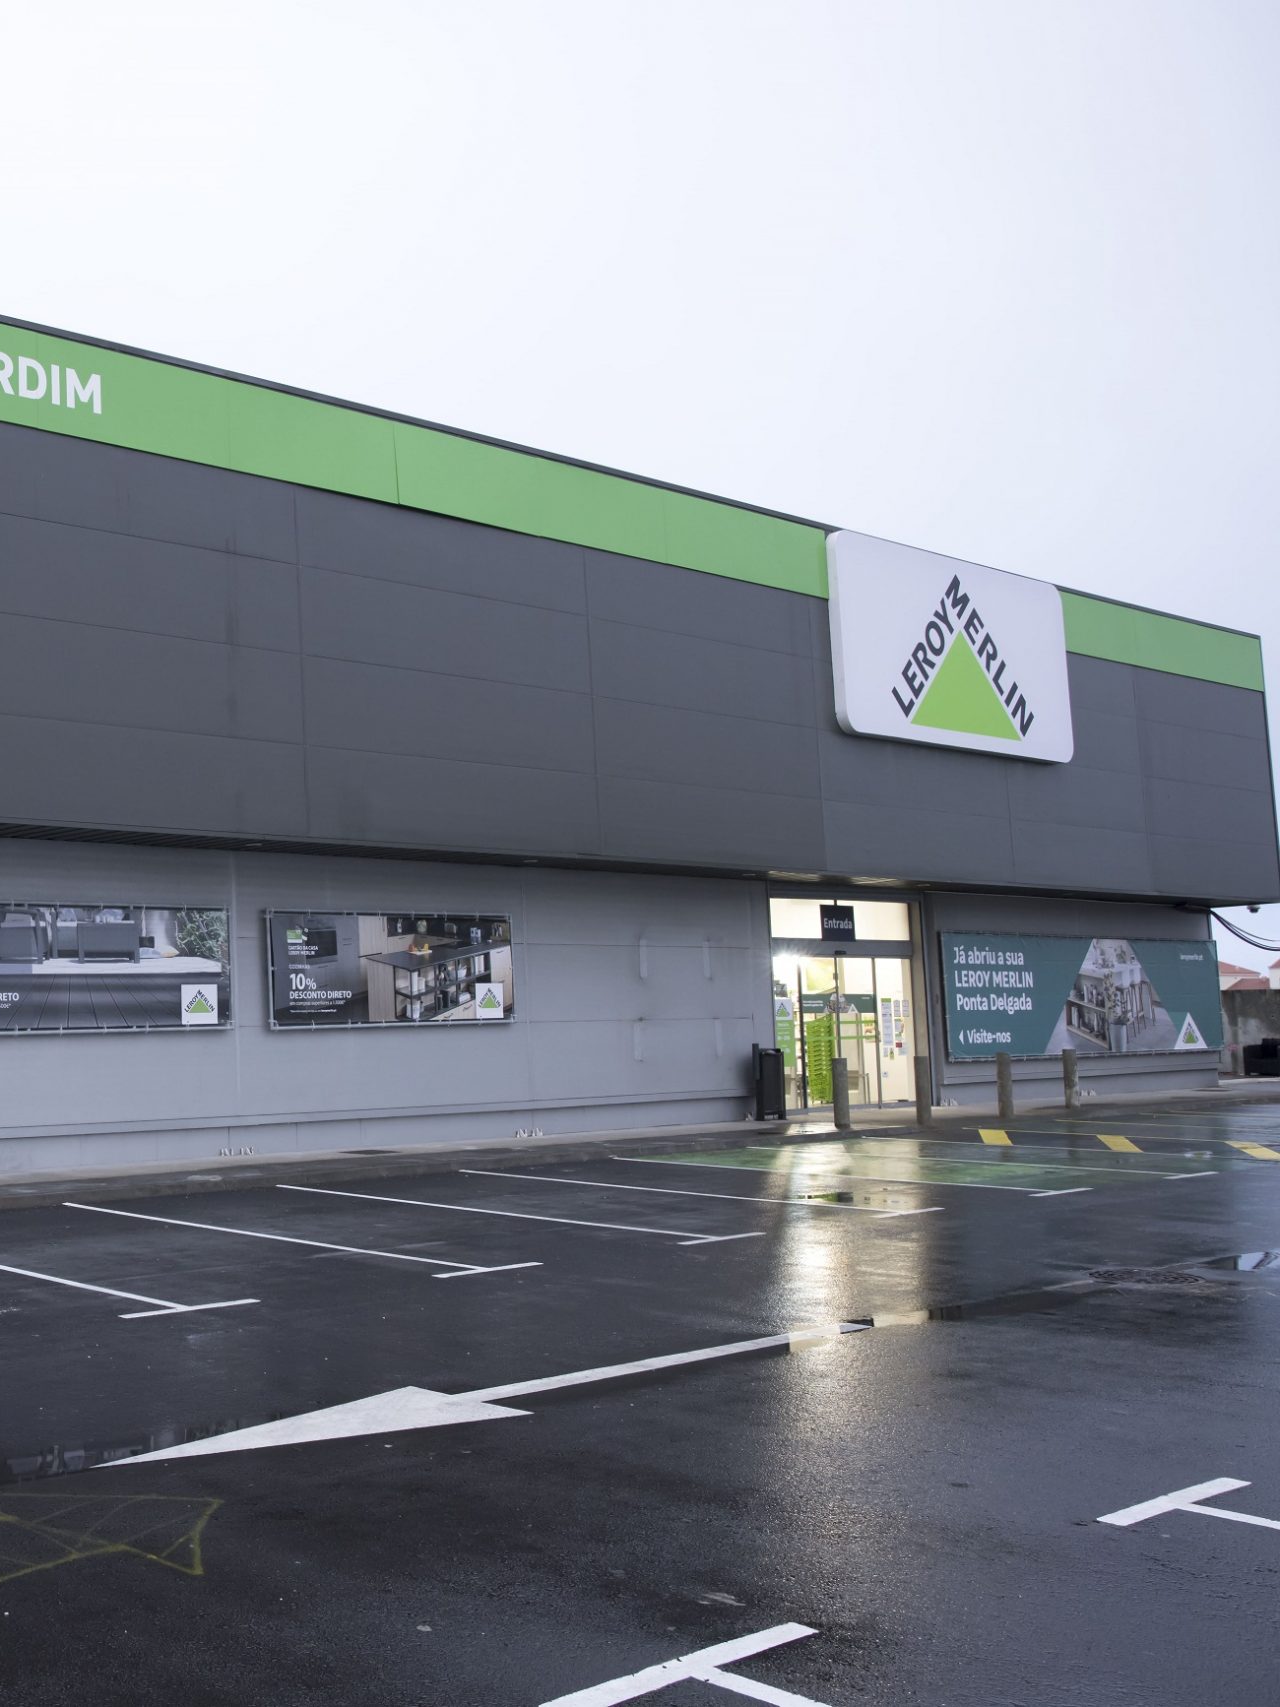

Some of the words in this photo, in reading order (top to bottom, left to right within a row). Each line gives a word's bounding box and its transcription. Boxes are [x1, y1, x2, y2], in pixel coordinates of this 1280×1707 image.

[891, 598, 955, 718] LEROY
[944, 574, 1035, 737] MERLIN
[823, 917, 853, 929] Entrada
[953, 945, 966, 964] Já
[967, 946, 996, 965] abriu
[997, 951, 1005, 966] a
[1005, 951, 1025, 966] sua
[289, 973, 317, 990] 10%
[954, 970, 991, 988] LEROY
[992, 970, 1034, 988] MERLIN
[184, 993, 199, 1013] LEROY
[197, 989, 216, 1012] MERLIN
[289, 990, 327, 999] DESCONTO
[327, 990, 353, 999] DIRETO
[956, 993, 989, 1011] Ponta
[990, 992, 1033, 1015] Delgada
[966, 1028, 1012, 1044] Visite-nos
